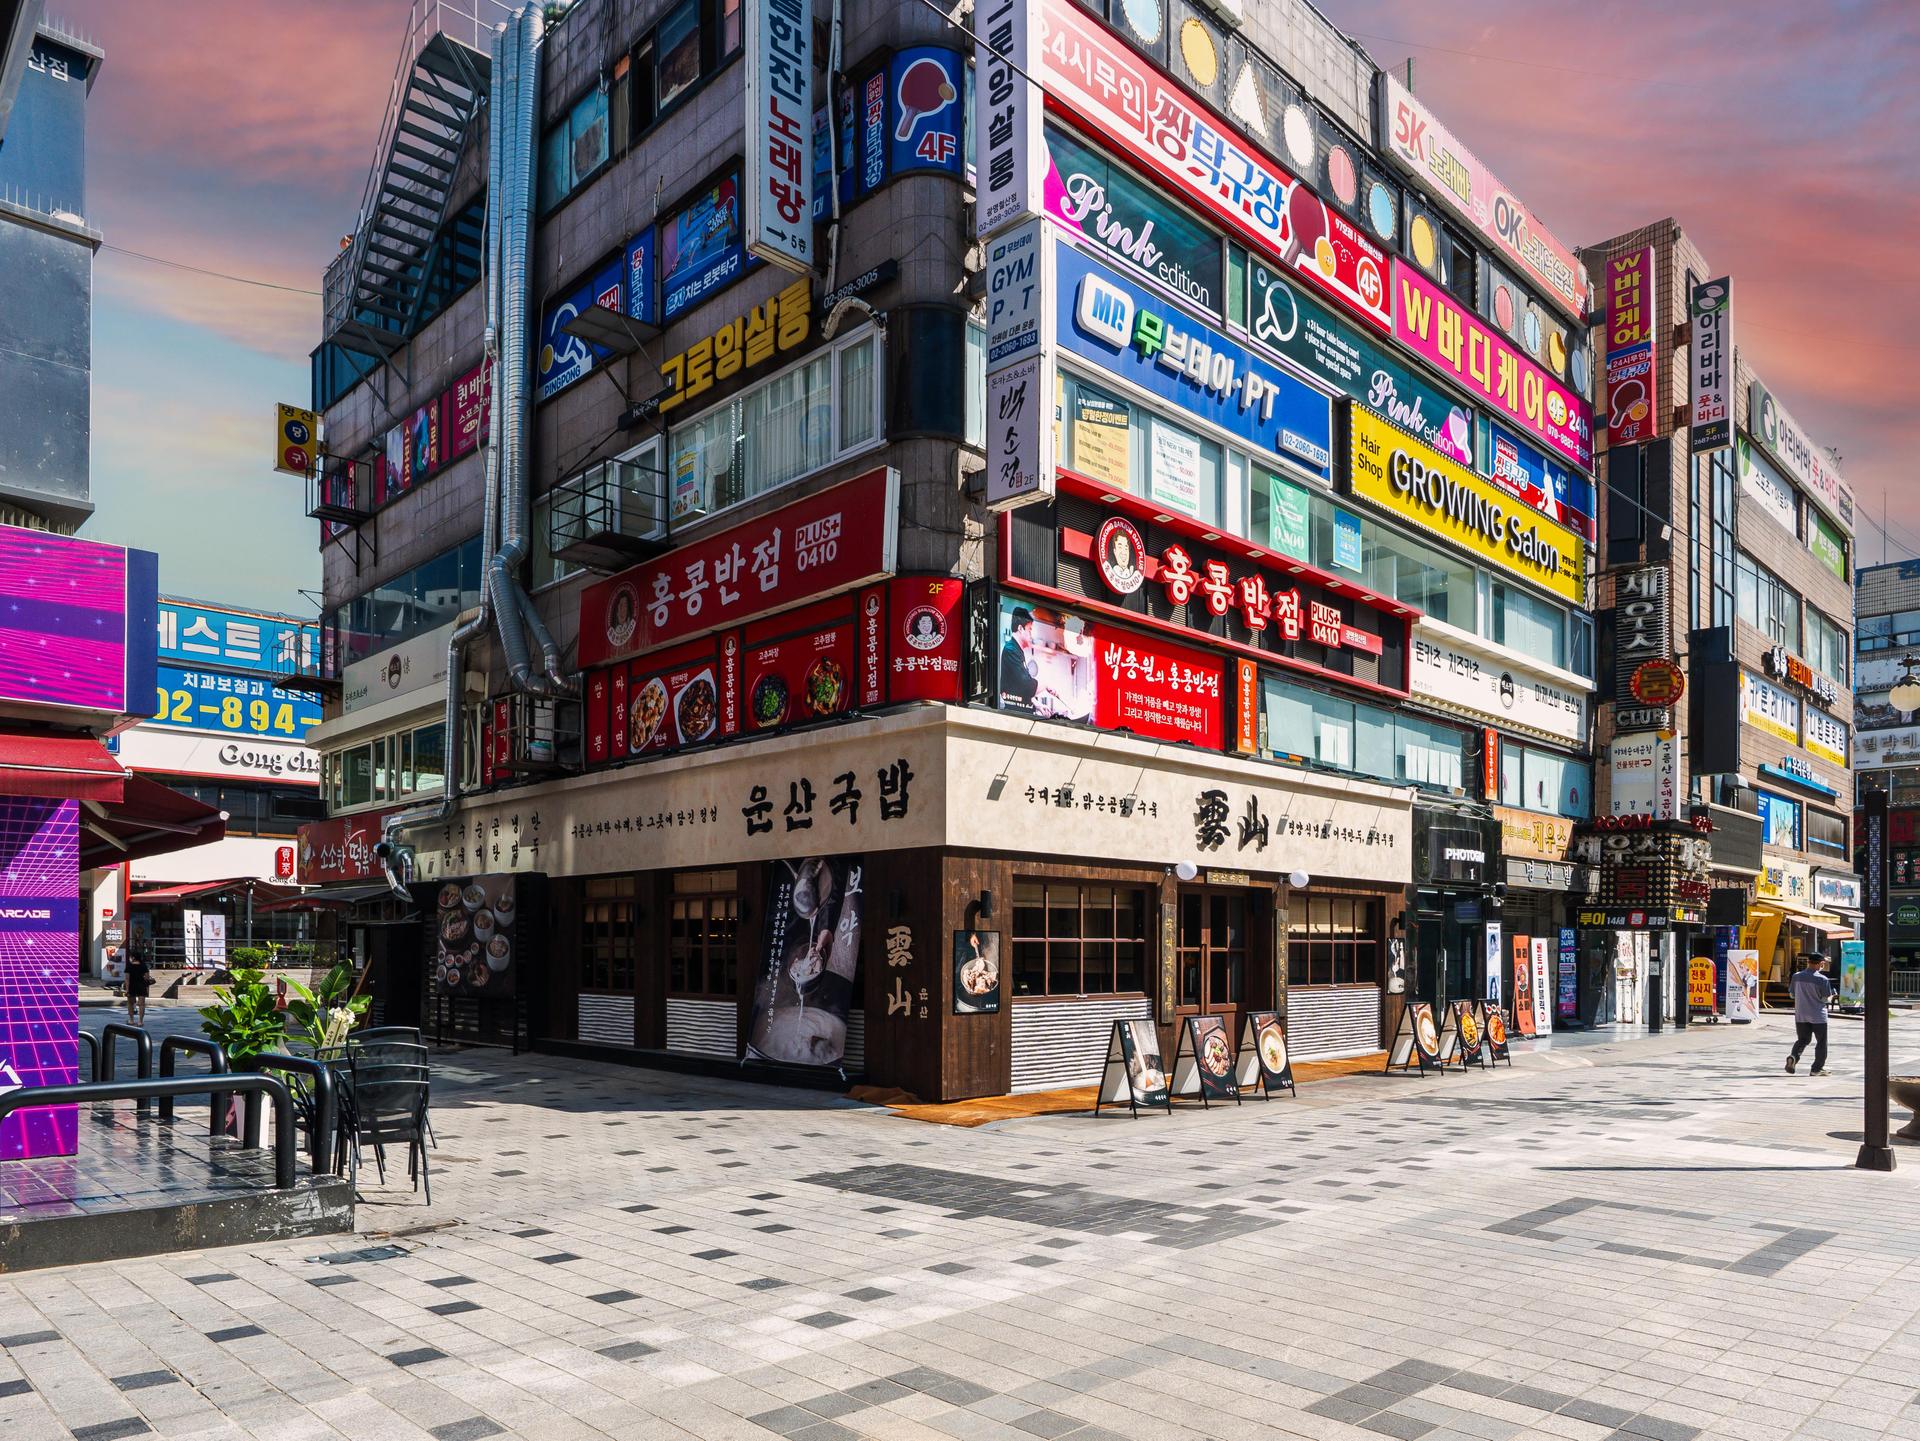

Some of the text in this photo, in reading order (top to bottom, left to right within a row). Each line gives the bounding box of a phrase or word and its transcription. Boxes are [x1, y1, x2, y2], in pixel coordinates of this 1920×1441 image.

[916, 131, 956, 163] 4F
[1395, 100, 1426, 162] 5K
[1151, 88, 1285, 230] 짱탁구장
[1428, 134, 1471, 207] 노래빠
[978, 203, 1021, 232] 02-898-3005
[1494, 196, 1523, 251] OK
[1060, 173, 1211, 307] Pink edition
[991, 253, 1034, 294] GYM
[1522, 225, 1576, 302] 노래연습장
[1614, 253, 1641, 272] W
[823, 269, 879, 309] 02-898-3005
[1360, 267, 1379, 300] 4F
[1613, 272, 1641, 346] 바디케어
[658, 276, 812, 415] 그로잉살롱
[1402, 279, 1545, 431] W 바디케어
[1700, 308, 1722, 390] 아리바바
[543, 365, 581, 398] PINGPONG
[991, 366, 1036, 389] 돈카츠&소바
[1368, 370, 1455, 458] Pink edition
[1569, 409, 1588, 442] 24h
[1697, 405, 1725, 422] 바디
[1360, 433, 1381, 457] Hair
[1619, 422, 1640, 440] 4F
[1284, 433, 1328, 464] 02-2060-1693
[1779, 418, 1812, 478] 아리바바
[1024, 474, 1034, 486] 2F
[1358, 452, 1384, 481] Shop
[1555, 473, 1567, 496] 4F
[1393, 449, 1504, 542] GROWING
[1508, 515, 1559, 573] Salon
[797, 516, 840, 550] PLUS+
[797, 539, 837, 572] 0410
[646, 527, 783, 628] 홍콩반점
[928, 583, 943, 594] 2F
[1163, 547, 1299, 639] 홍콩반점
[1312, 603, 1341, 625] PLUS+
[1621, 569, 1660, 661] 제우스
[1313, 625, 1339, 645] 0410
[866, 617, 878, 689] 홍콩반점
[893, 655, 942, 672] 홍콩반점
[1104, 641, 1219, 697] 백종원의 홍콩반점
[1415, 640, 1480, 682] 돈카츠 치즈카츠
[183, 672, 265, 697] 치과보철과
[219, 744, 284, 775] Gong
[741, 758, 913, 836] 운산국밥
[1137, 800, 1158, 819] 수육
[635, 815, 643, 832] 한
[646, 812, 674, 829] 그릇에
[676, 809, 695, 825] 담긴
[1531, 821, 1567, 853] 제우스
[320, 845, 346, 874] 소소한
[1469, 868, 1476, 880] 1
[268, 876, 292, 887] Gong
[1560, 929, 1575, 939] OPEN
[1580, 912, 1606, 926] 루이
[1607, 916, 1625, 926] 14세
[1691, 969, 1706, 981] 전통
